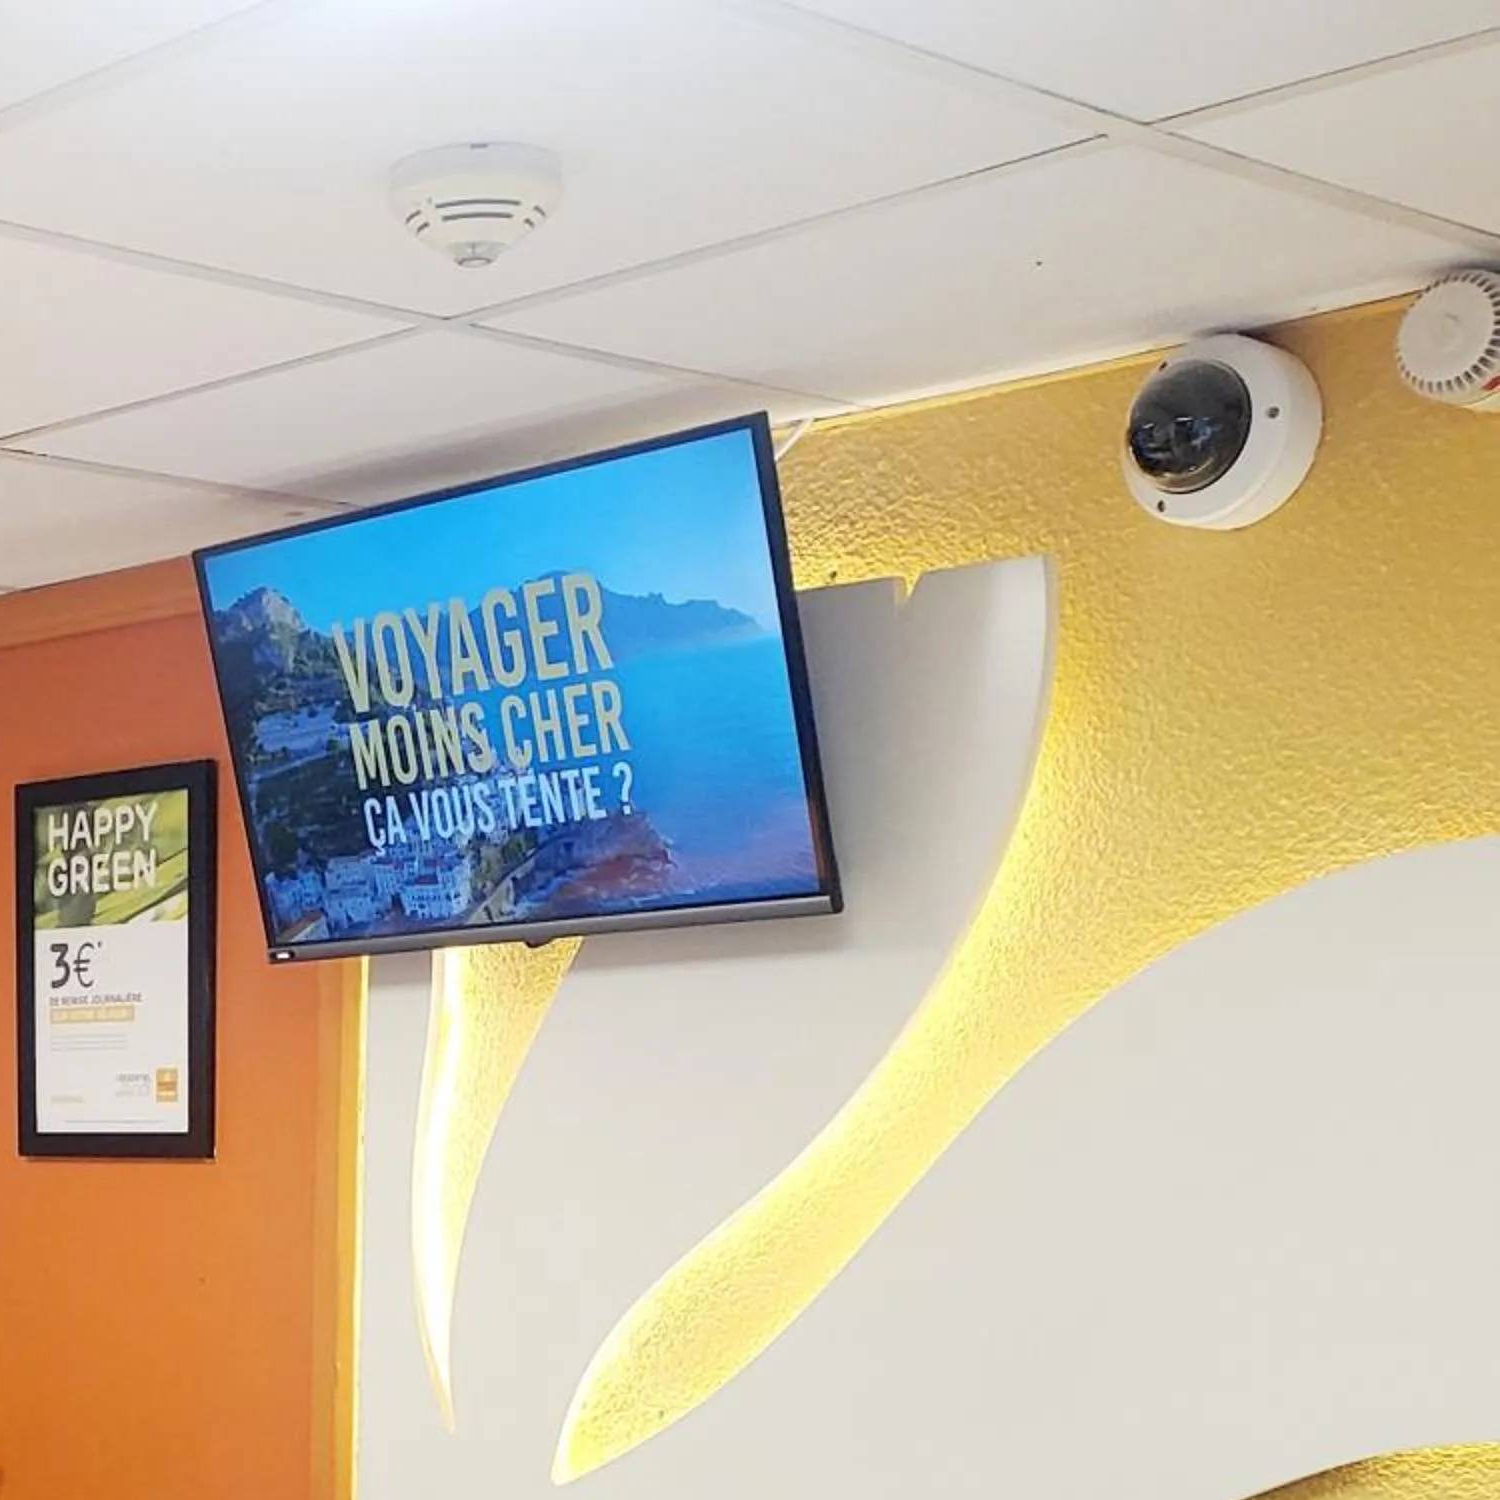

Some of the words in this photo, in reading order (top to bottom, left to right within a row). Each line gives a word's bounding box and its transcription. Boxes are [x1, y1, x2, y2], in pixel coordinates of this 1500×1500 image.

[331, 572, 614, 713] VOYAGER
[351, 702, 496, 790] MOINS
[501, 680, 631, 770] CHER
[49, 801, 158, 852] HAPPY
[363, 796, 407, 856] ÇA
[408, 784, 496, 842] VOUS
[499, 765, 607, 830] TENTE
[612, 761, 634, 816] ?
[48, 848, 157, 897] GREEN
